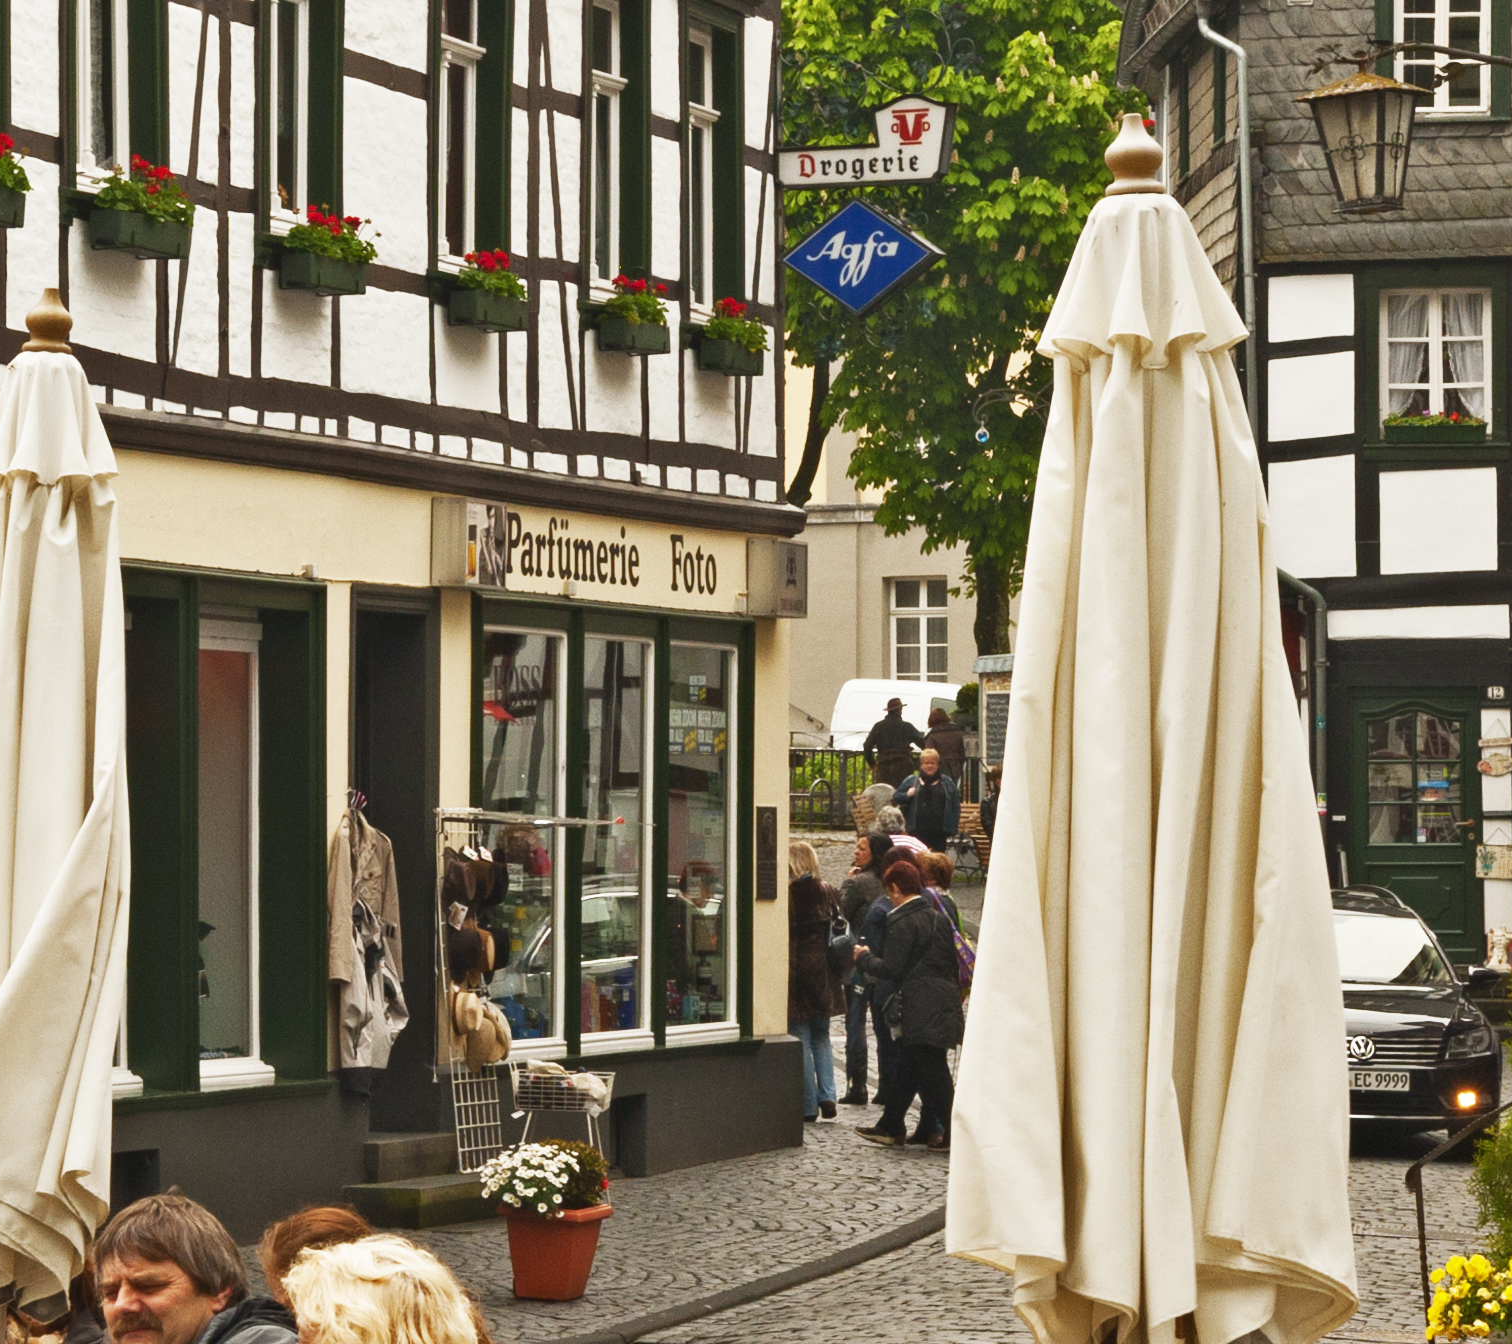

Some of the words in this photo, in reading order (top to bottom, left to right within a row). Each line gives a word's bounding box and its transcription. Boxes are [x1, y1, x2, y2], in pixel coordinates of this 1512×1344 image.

[797, 148, 919, 180] Drogerie
[806, 230, 899, 287] Agfa
[506, 512, 640, 587] Parfümerie
[670, 534, 718, 596] Foto
[1490, 687, 1501, 698] 12
[1354, 1072, 1372, 1088] EC
[1375, 1073, 1408, 1089] 9999
